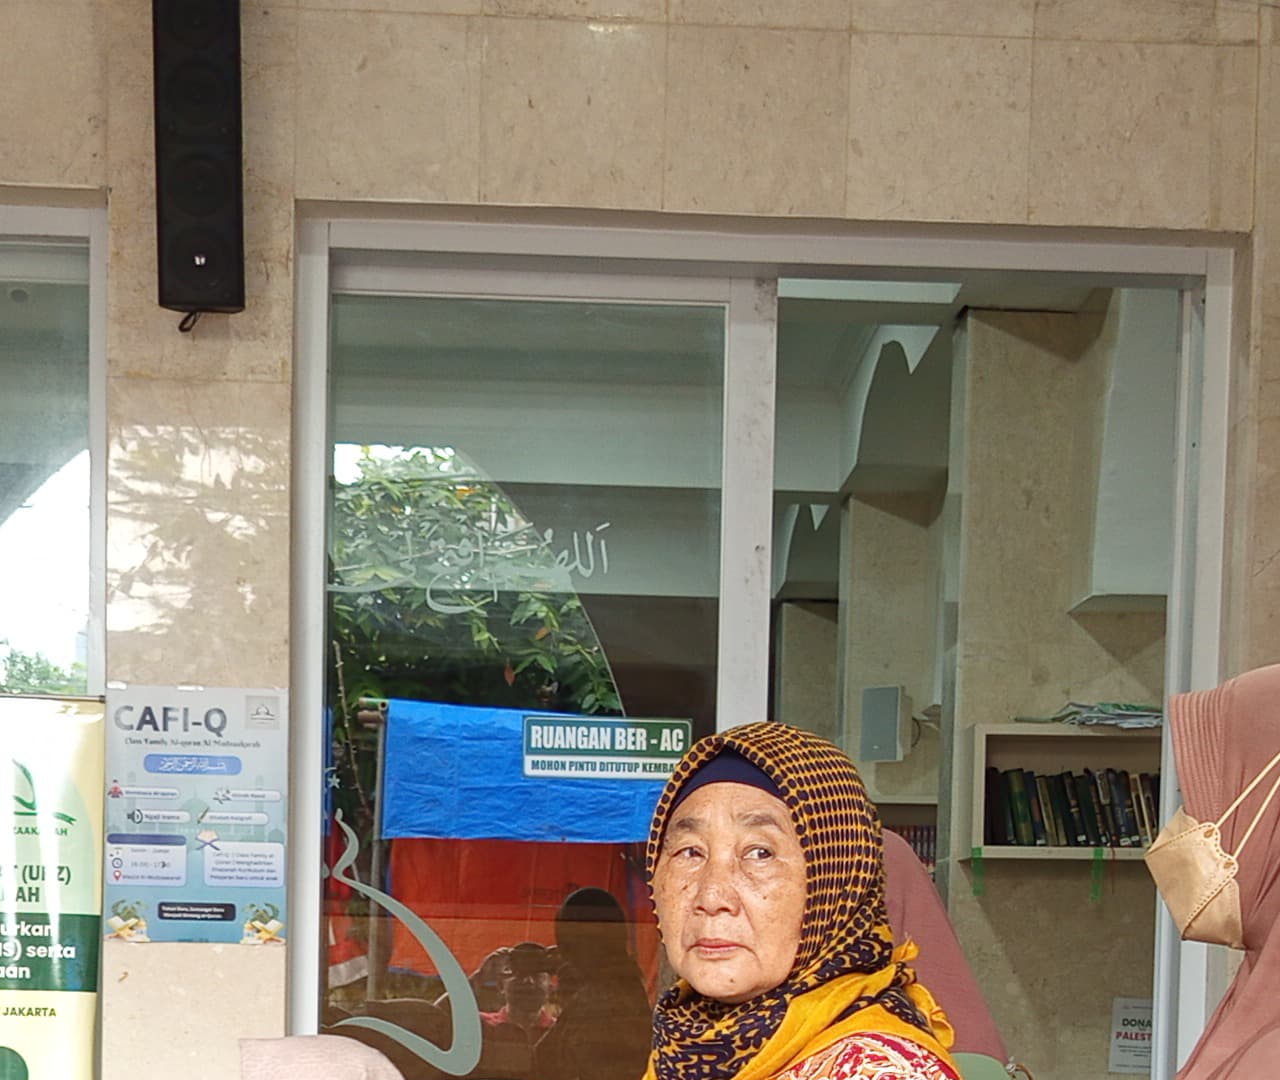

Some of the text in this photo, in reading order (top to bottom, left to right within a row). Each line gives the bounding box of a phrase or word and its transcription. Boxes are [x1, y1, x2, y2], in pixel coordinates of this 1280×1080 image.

[114, 705, 227, 737] CAFI-Q
[531, 726, 611, 749] RUANGAN
[614, 727, 646, 750] BER
[660, 728, 684, 751] AC
[531, 760, 674, 774] MOHON PINTU DITUTUP KEMBA
[26, 943, 76, 959] serta
[3, 1006, 57, 1017] JAKARTA
[1122, 1018, 1152, 1028] DONA
[1115, 1031, 1152, 1041] PALEST
